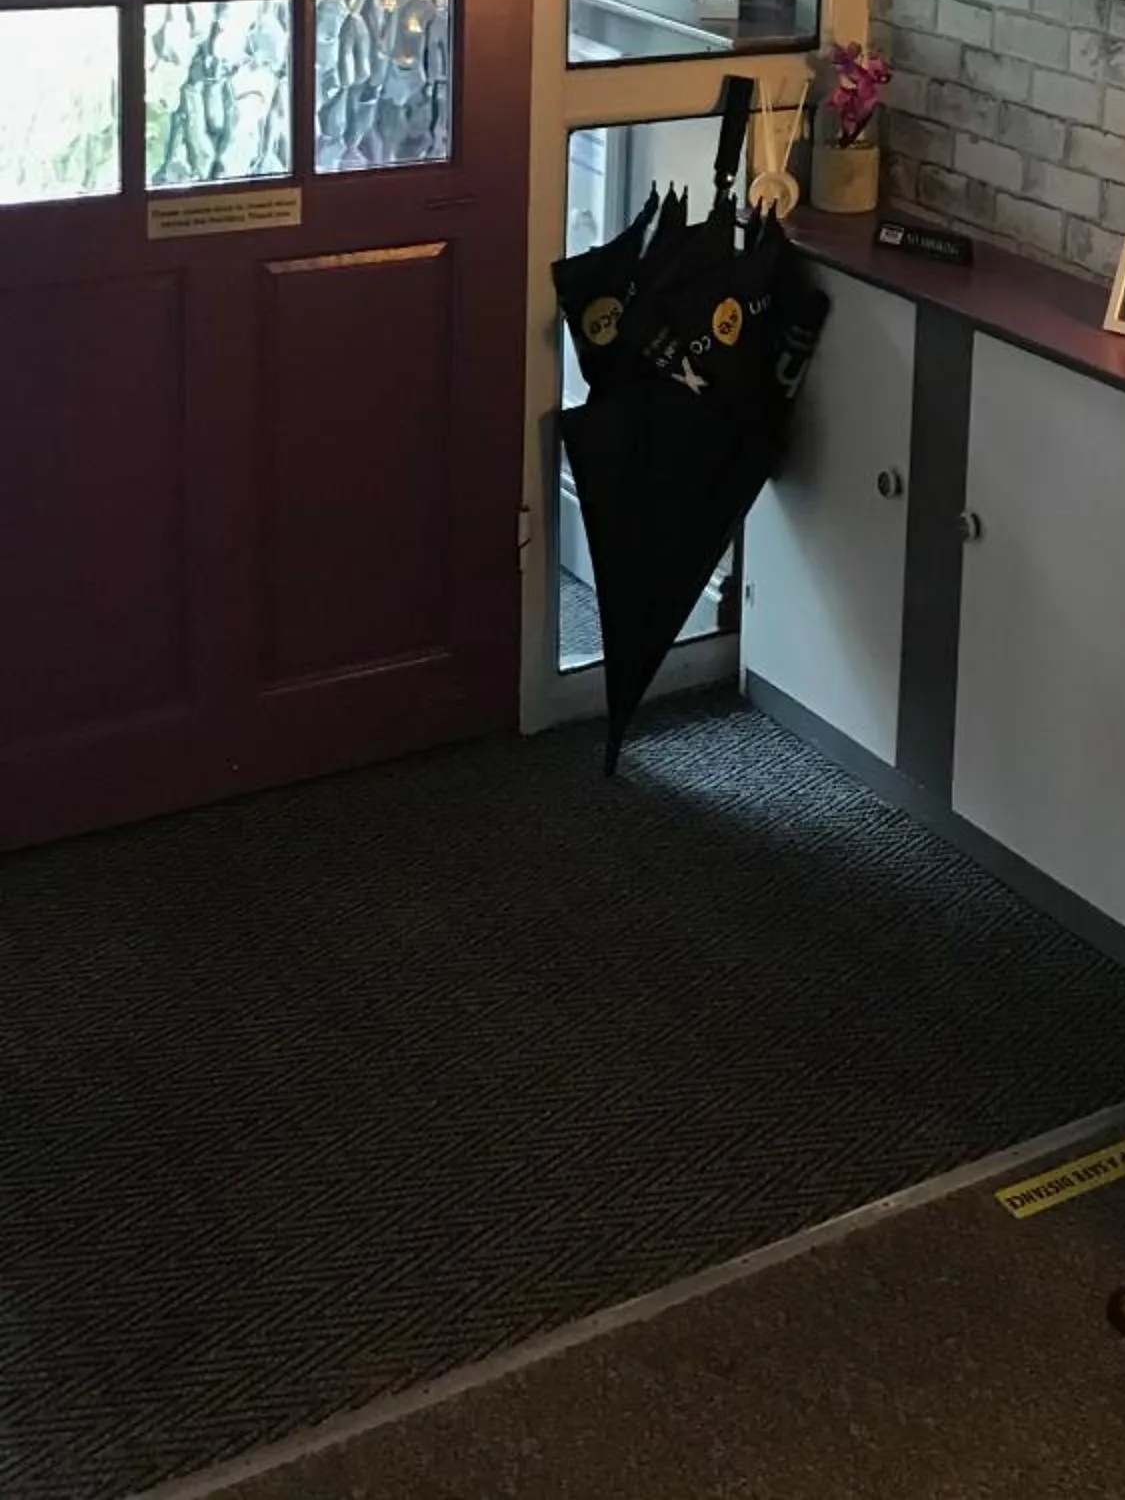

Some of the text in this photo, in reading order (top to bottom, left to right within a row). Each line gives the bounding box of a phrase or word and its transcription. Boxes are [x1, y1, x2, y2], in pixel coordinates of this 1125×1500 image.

[1071, 1160, 1111, 1184] SAFE
[1107, 1156, 1118, 1169] A
[1006, 1176, 1075, 1211] DISTANCE
